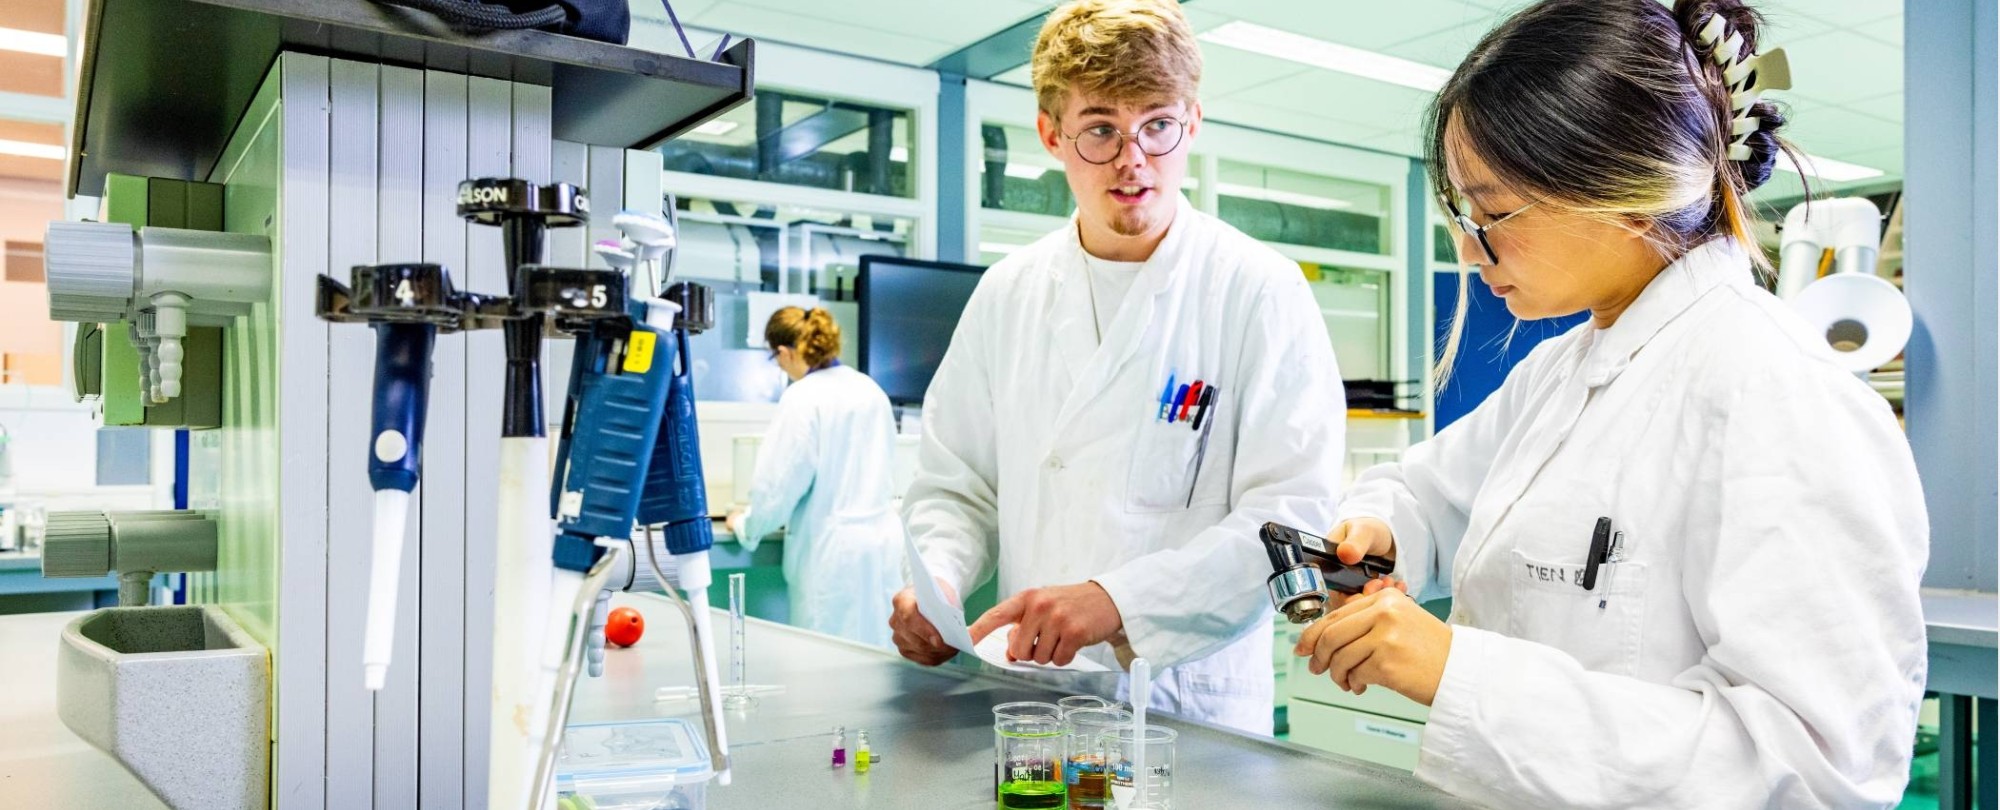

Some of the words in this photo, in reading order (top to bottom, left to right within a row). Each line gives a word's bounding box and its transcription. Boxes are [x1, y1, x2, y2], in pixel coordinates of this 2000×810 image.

[395, 280, 413, 306] 4
[592, 285, 608, 307] 5
[1526, 564, 1566, 582] TIEN
